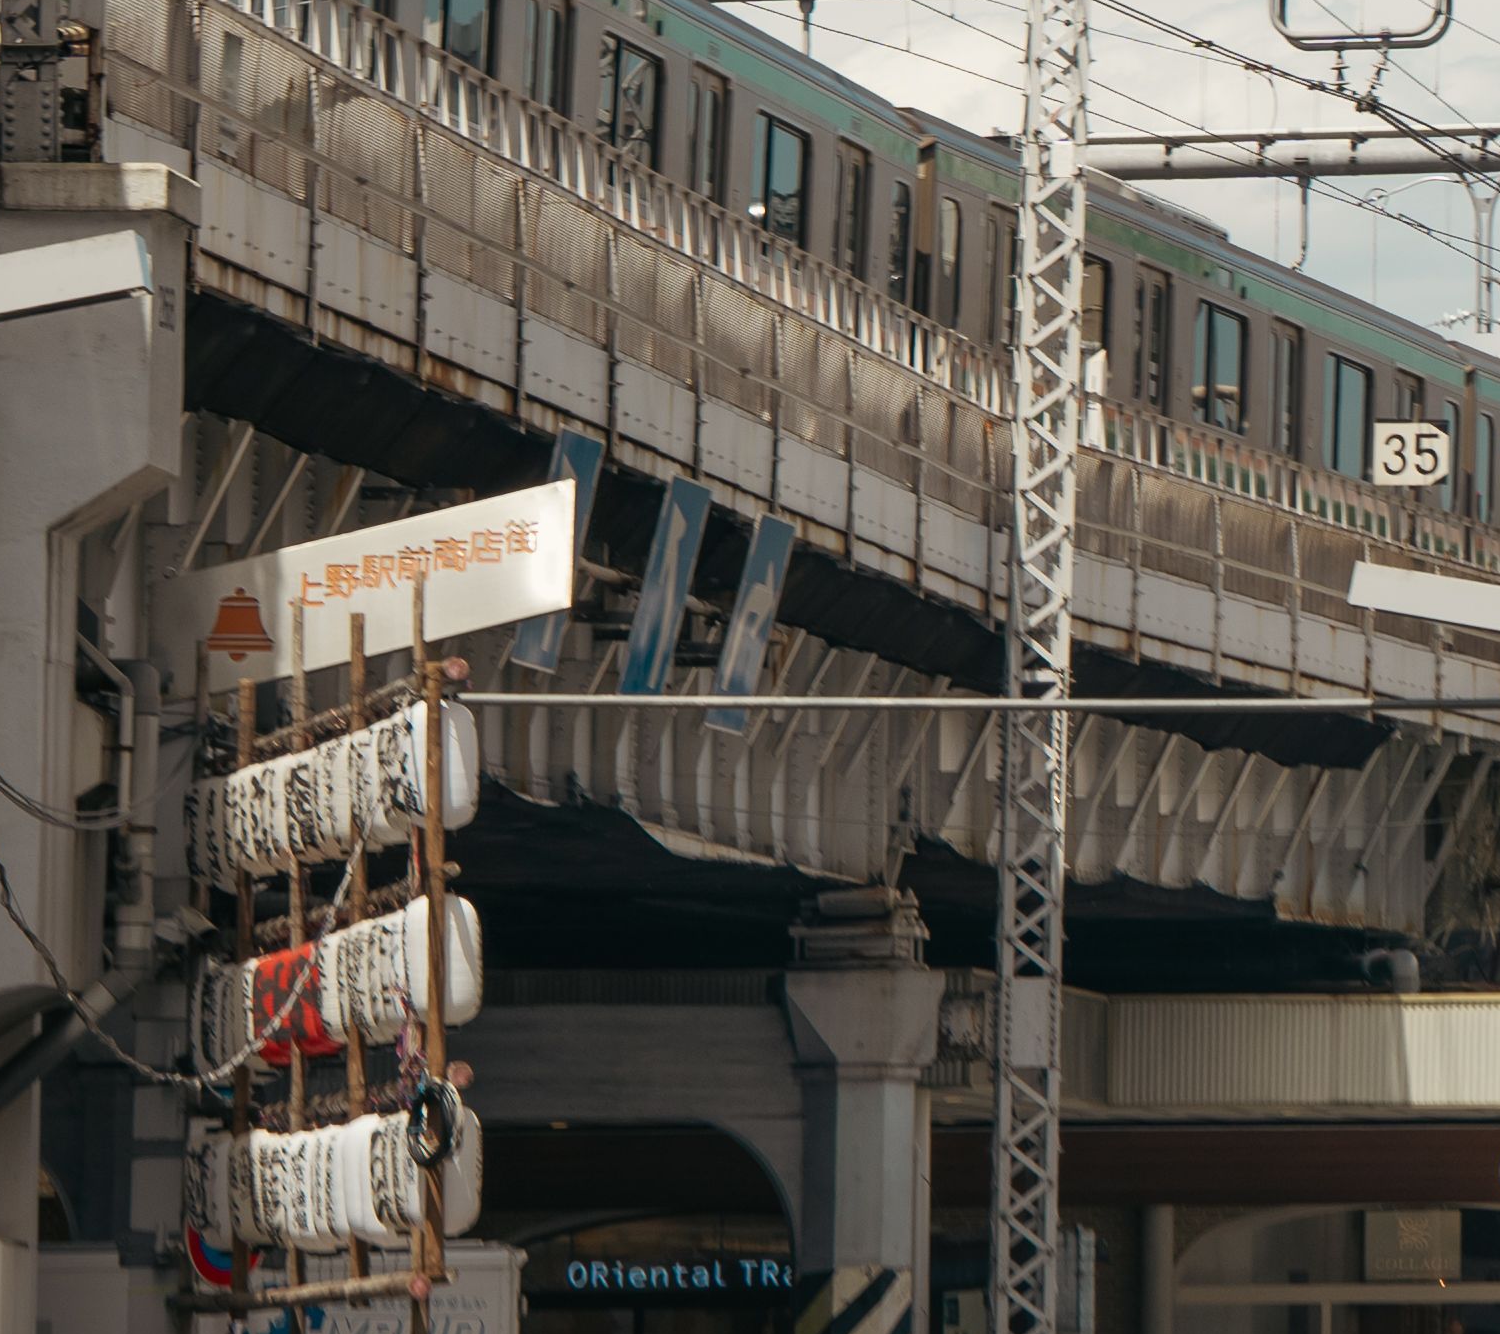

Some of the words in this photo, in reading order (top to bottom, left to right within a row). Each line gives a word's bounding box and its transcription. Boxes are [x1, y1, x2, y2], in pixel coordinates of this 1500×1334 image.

[1382, 432, 1442, 478] 35
[288, 519, 538, 609] 上野駅前商店街
